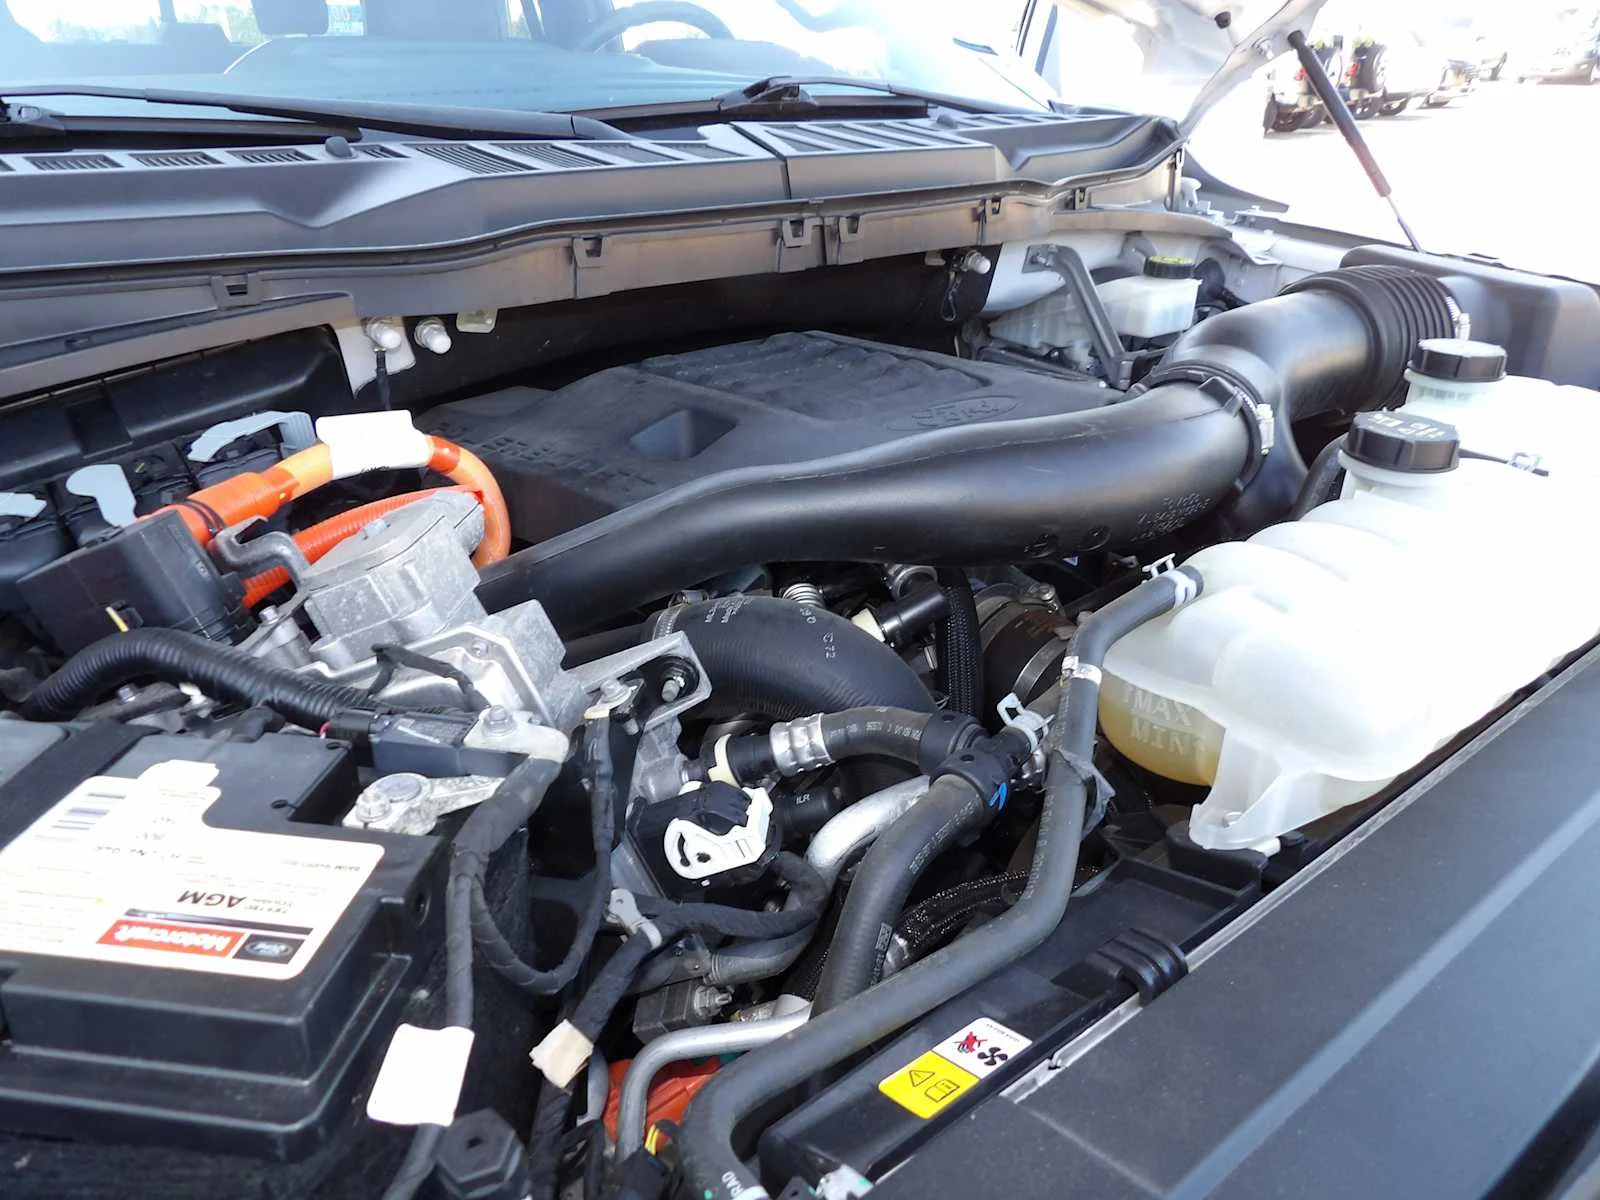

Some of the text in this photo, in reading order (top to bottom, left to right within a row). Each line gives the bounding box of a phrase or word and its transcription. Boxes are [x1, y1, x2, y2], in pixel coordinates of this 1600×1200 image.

[1133, 686, 1191, 727] MAX
[1130, 716, 1187, 756] MIN
[176, 889, 248, 909] AGM
